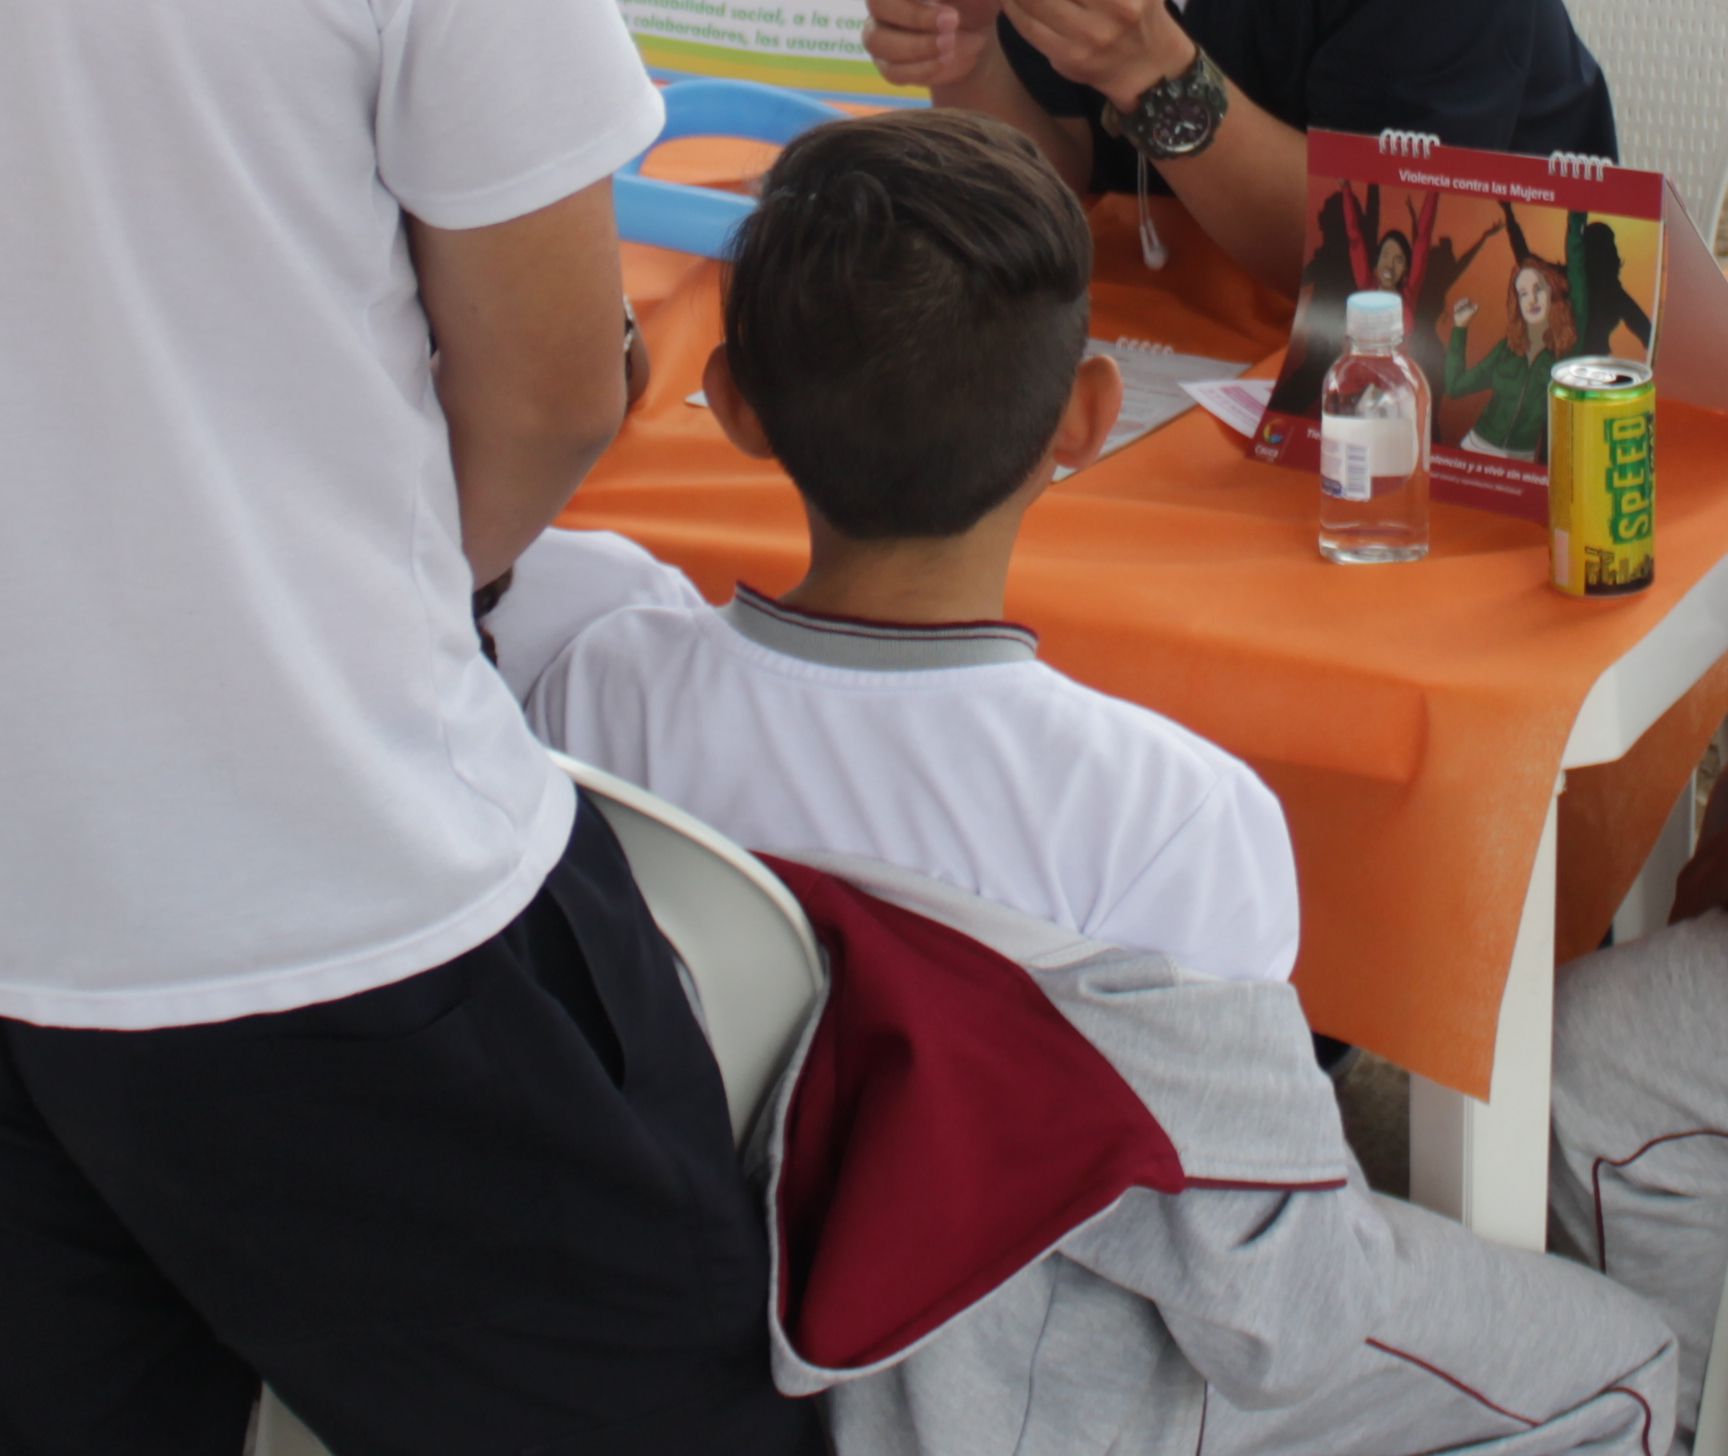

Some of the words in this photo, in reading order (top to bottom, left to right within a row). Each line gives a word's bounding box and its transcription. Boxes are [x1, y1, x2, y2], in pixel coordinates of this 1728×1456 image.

[1399, 168, 1450, 188] Violencia
[1452, 177, 1489, 192] contra
[1492, 181, 1506, 196] las
[1510, 183, 1555, 202] Mujeres
[1613, 415, 1649, 539] SPEED
